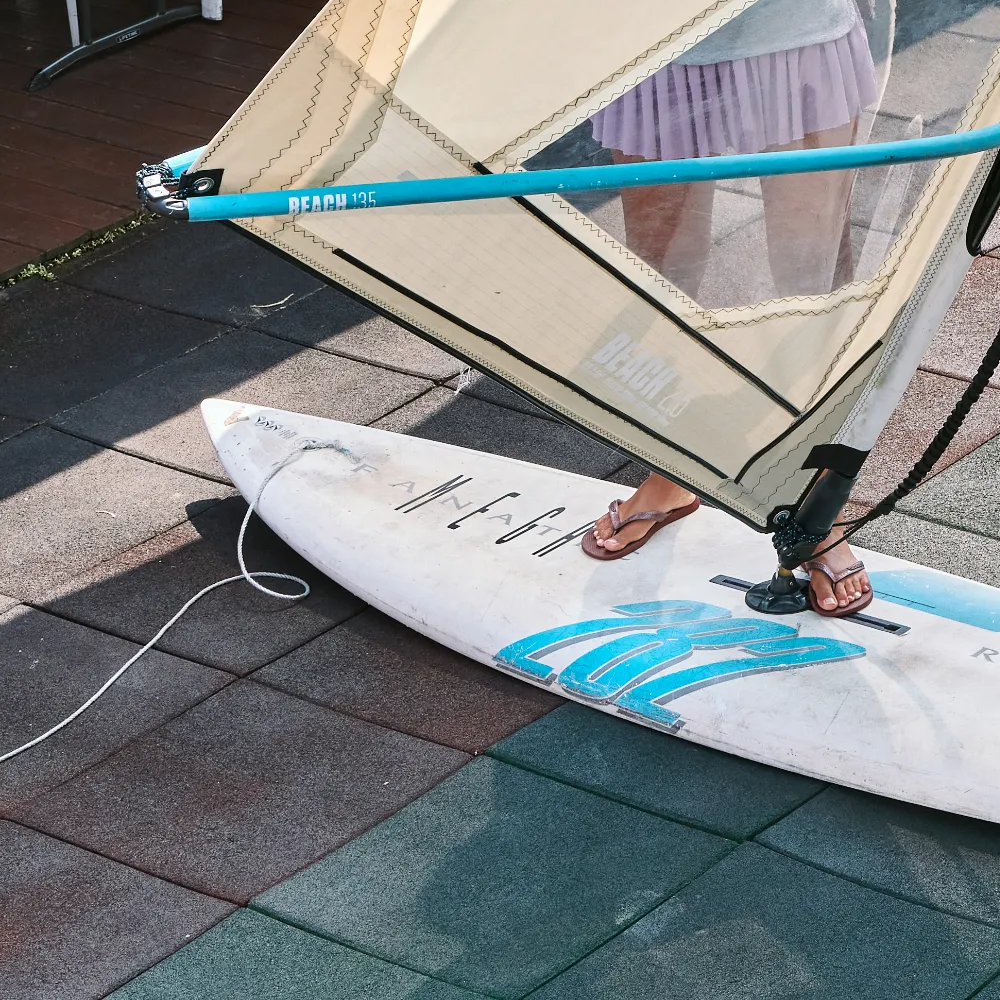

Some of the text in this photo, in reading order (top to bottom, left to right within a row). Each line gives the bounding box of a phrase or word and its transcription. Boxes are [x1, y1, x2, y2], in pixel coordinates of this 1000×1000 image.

[288, 191, 377, 215] BEACH 135
[591, 332, 680, 400] BEACH
[350, 462, 640, 561] FANAT
